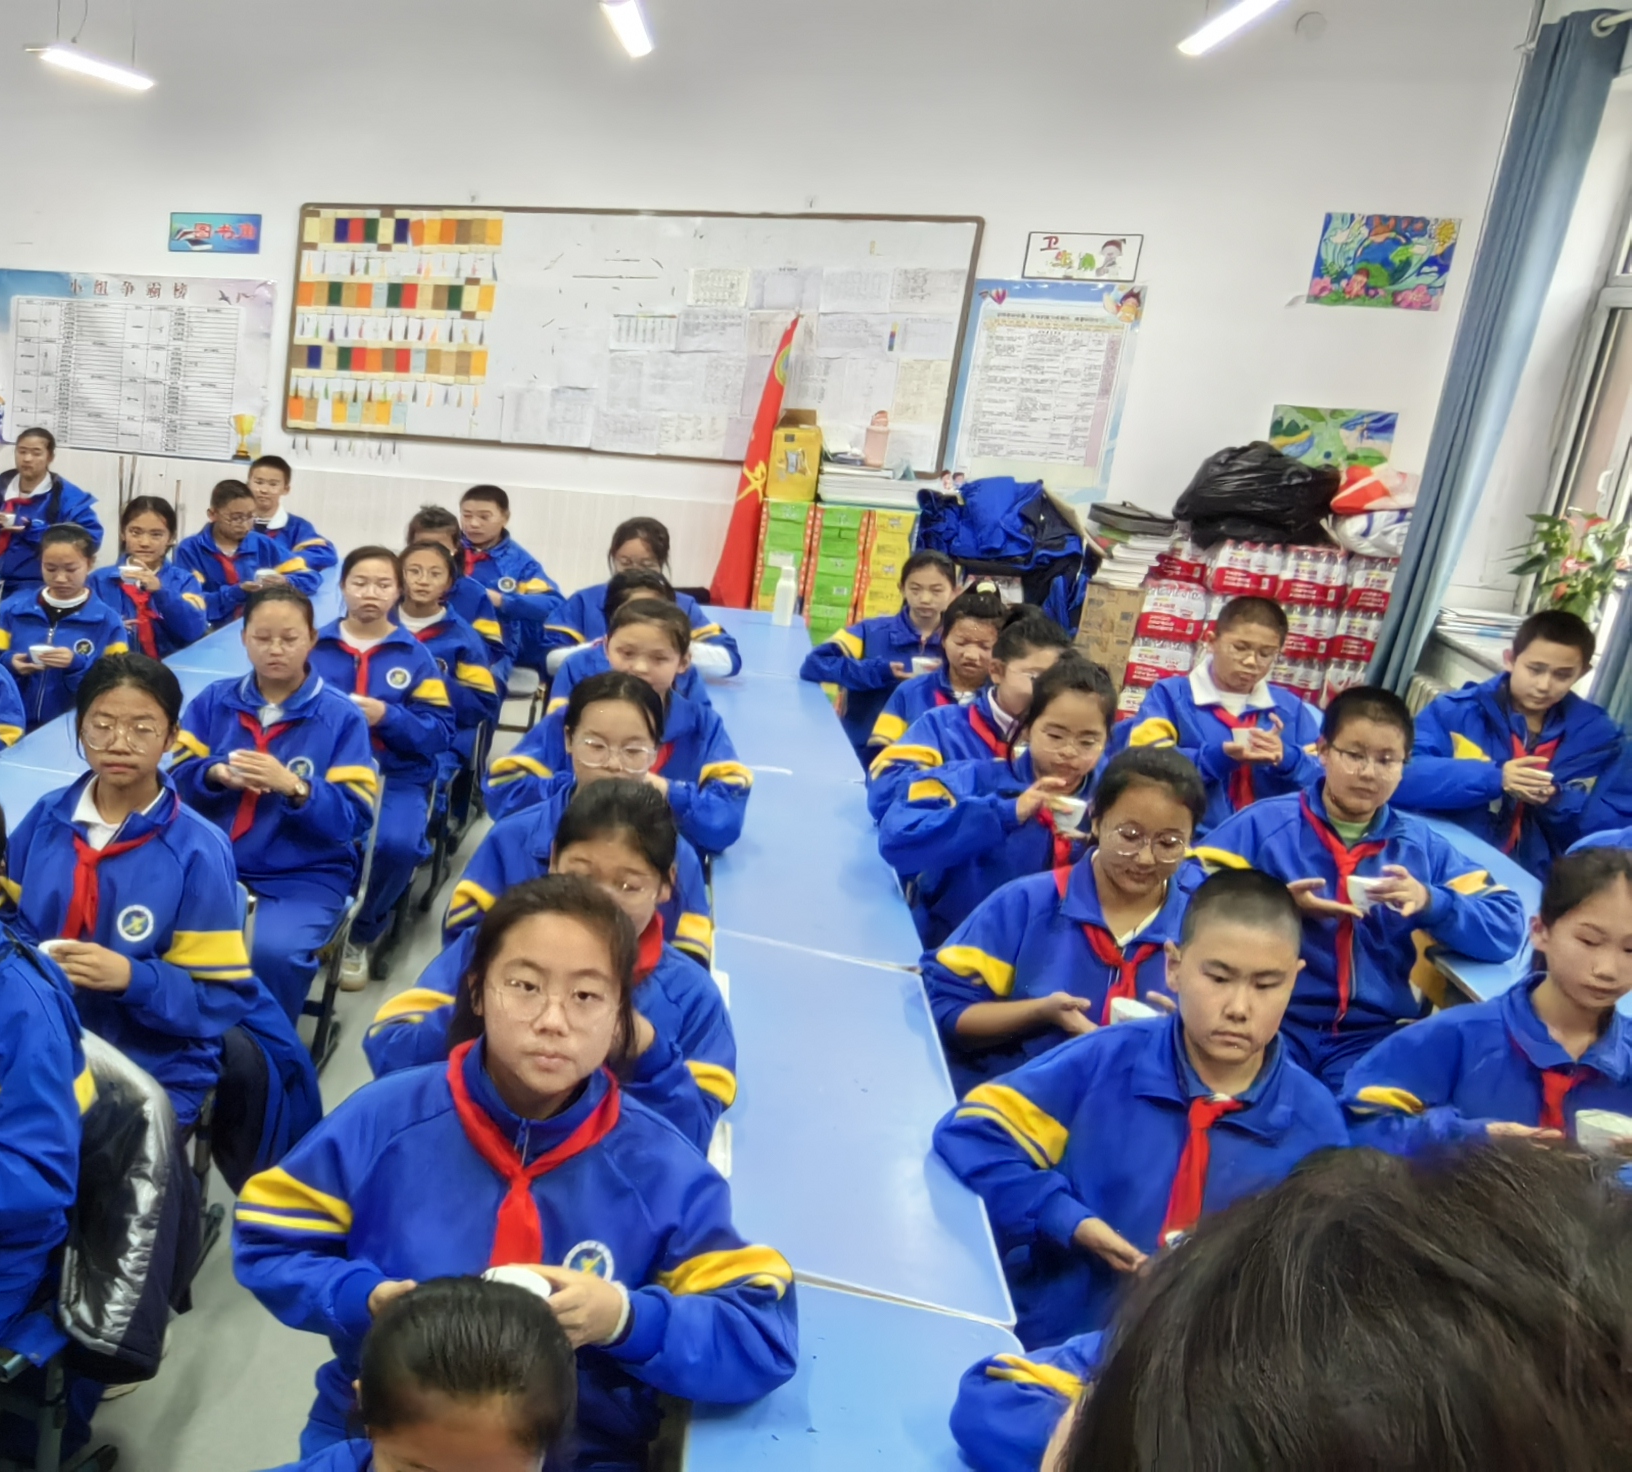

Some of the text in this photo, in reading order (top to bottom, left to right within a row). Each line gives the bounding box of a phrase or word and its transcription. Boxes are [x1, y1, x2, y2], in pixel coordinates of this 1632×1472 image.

[194, 222, 257, 241] 图书角
[70, 278, 188, 300] 小组争霸榜
